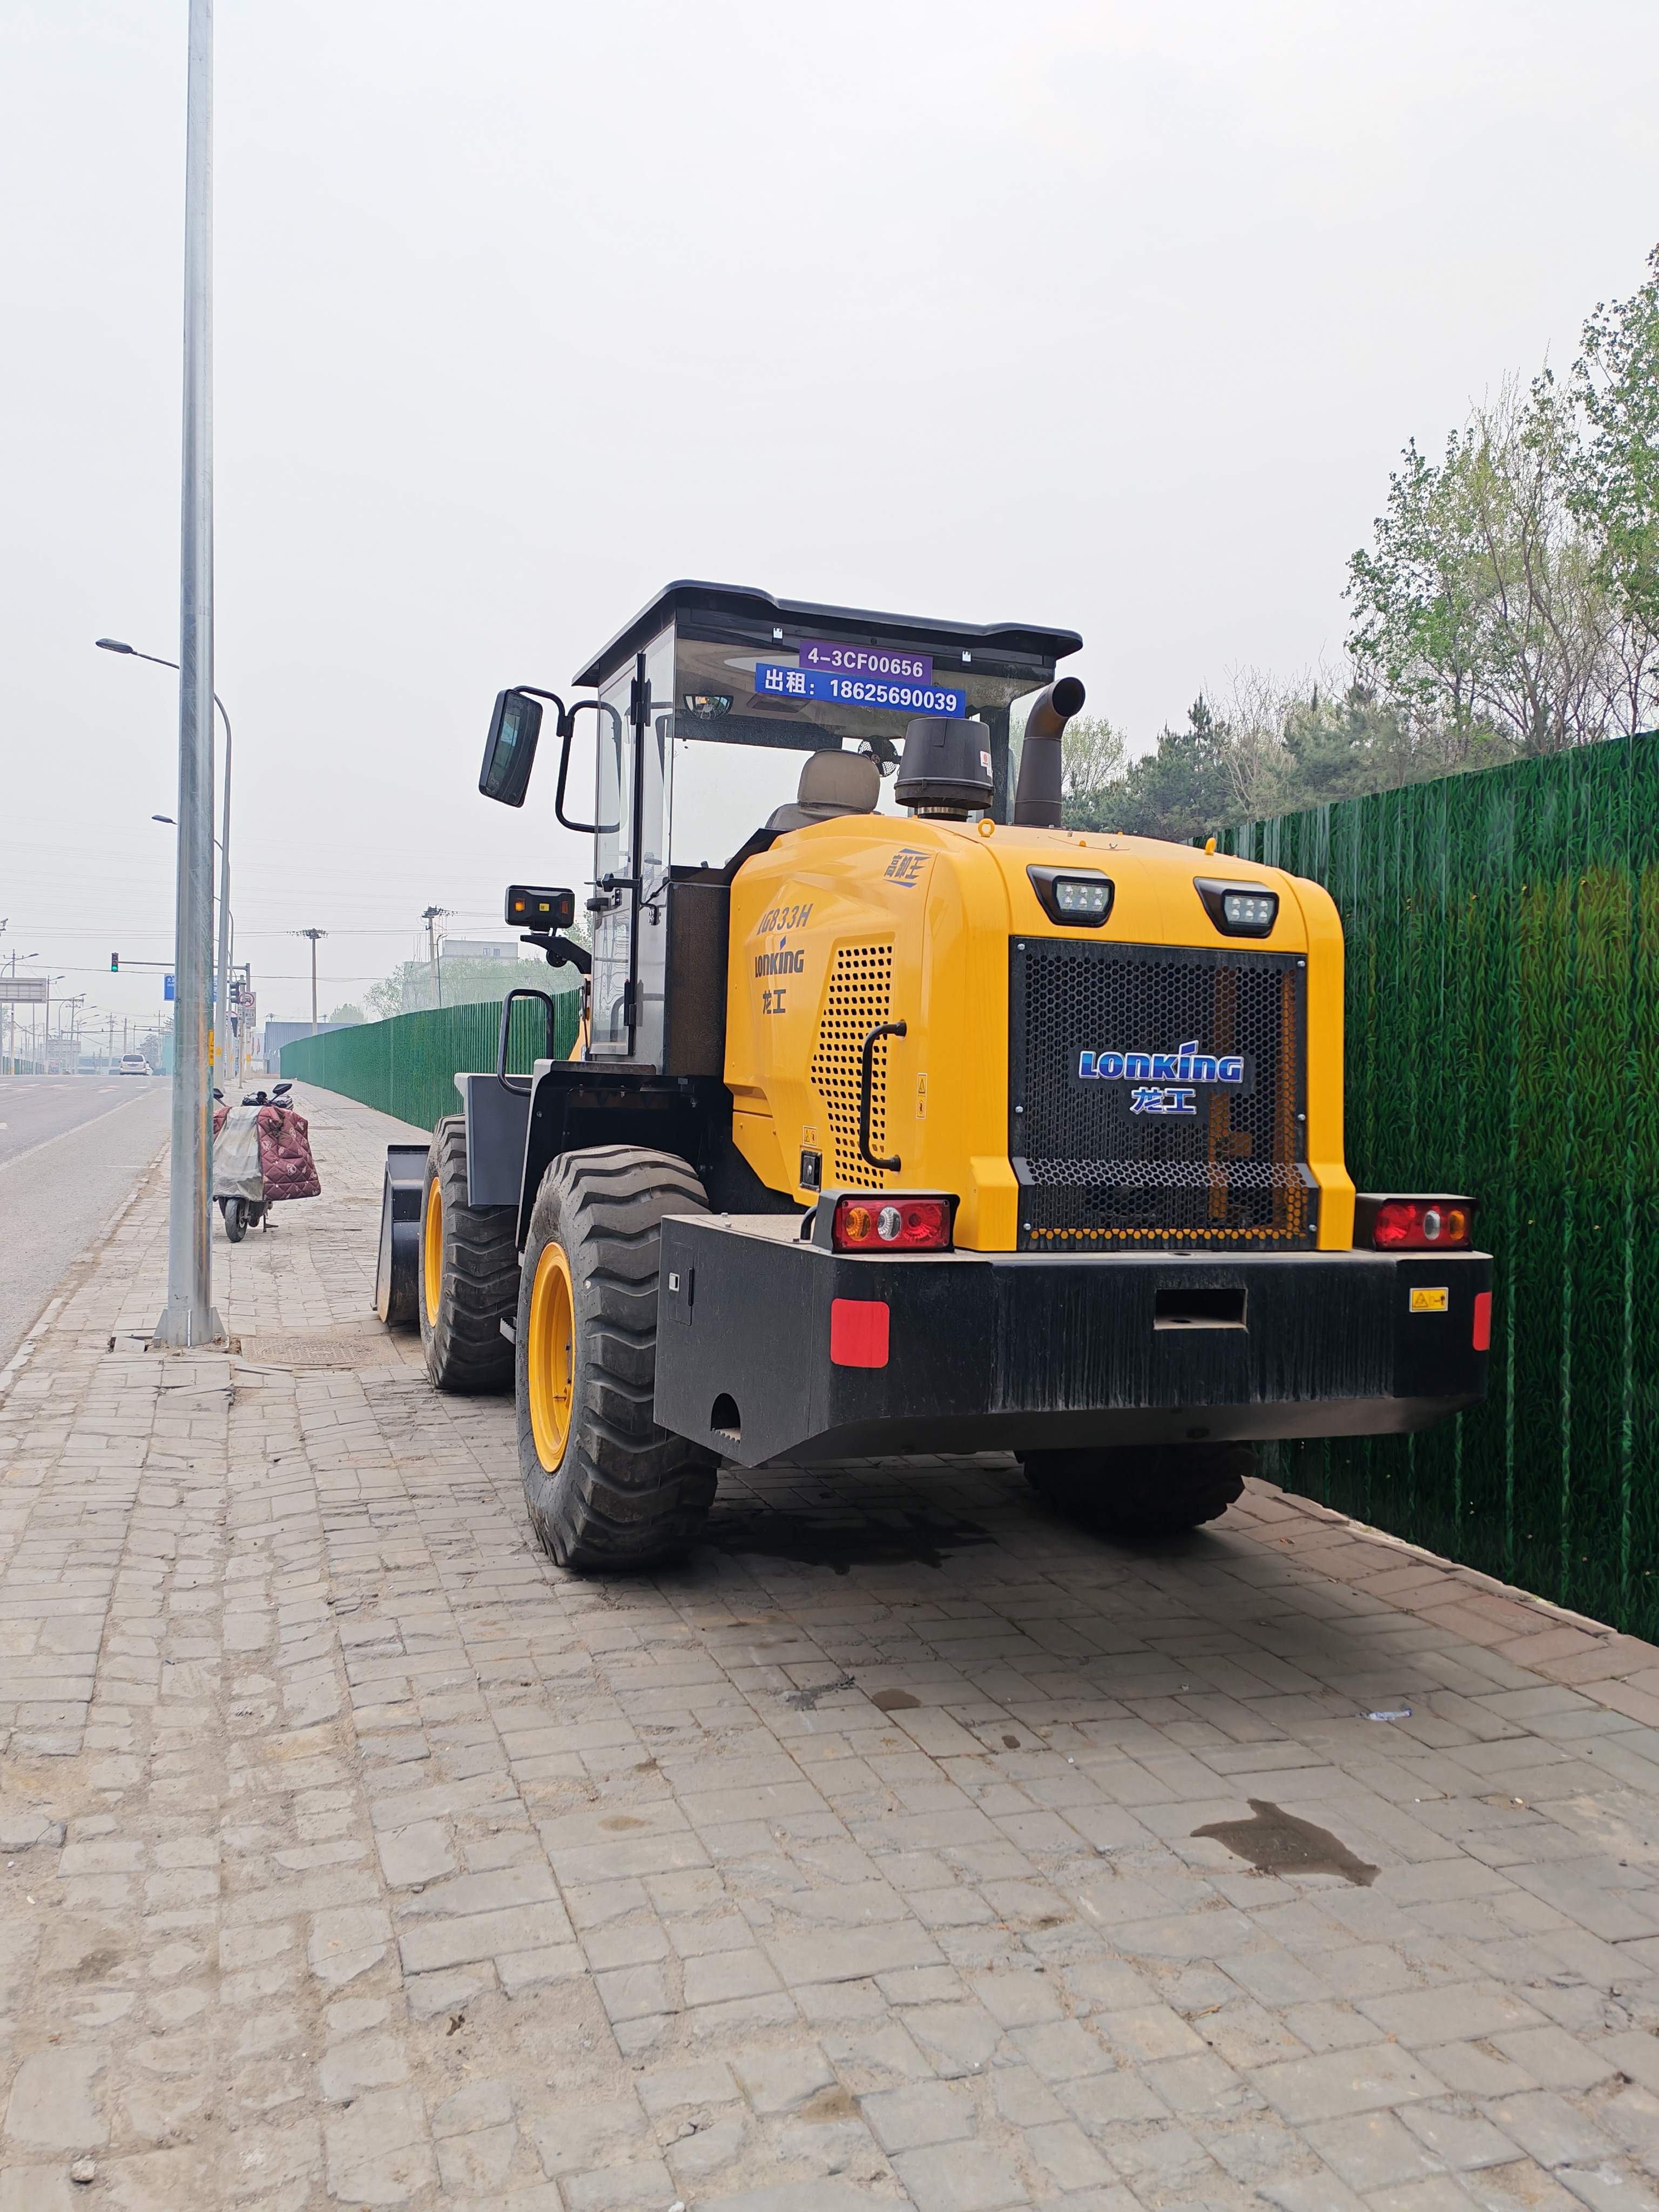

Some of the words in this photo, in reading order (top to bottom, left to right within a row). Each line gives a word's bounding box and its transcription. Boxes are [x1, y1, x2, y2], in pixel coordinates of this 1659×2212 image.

[808, 648, 923, 678] 4-3CF00656
[830, 679, 957, 712] 18625690039
[757, 903, 813, 935] LG833H
[762, 989, 786, 1015] 龙工
[1130, 1087, 1197, 1114] 龙工
